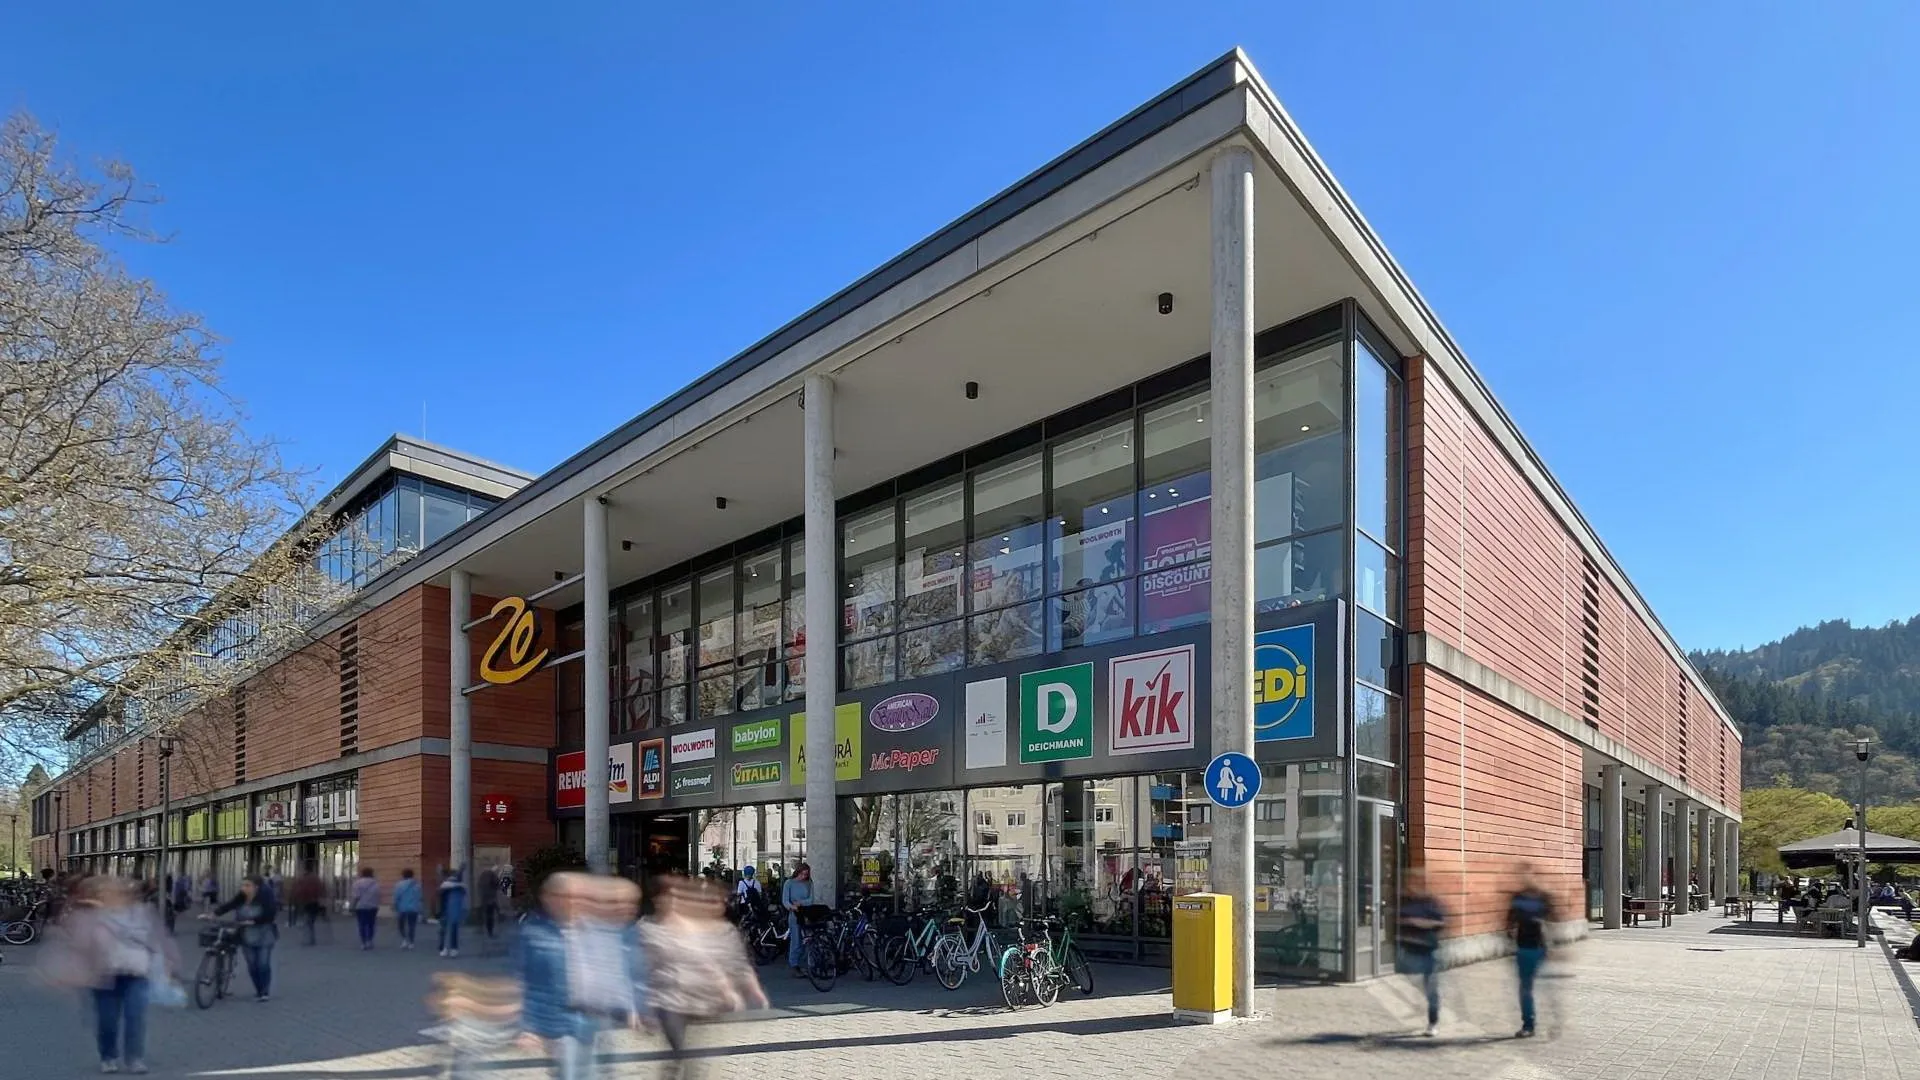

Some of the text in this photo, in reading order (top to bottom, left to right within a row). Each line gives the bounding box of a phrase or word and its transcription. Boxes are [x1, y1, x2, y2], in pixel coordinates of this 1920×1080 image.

[1143, 566, 1211, 592] DISCOUNT
[1253, 664, 1307, 704] EDi
[887, 699, 913, 711] AMERICAN
[1037, 682, 1078, 733] D
[735, 726, 776, 743] babylon
[672, 738, 714, 754] WOOLWORTH
[1028, 738, 1084, 752] DEICHMANN
[869, 748, 940, 772] McPaper
[643, 772, 660, 784] ALDI
[733, 765, 780, 784] VITALIA
